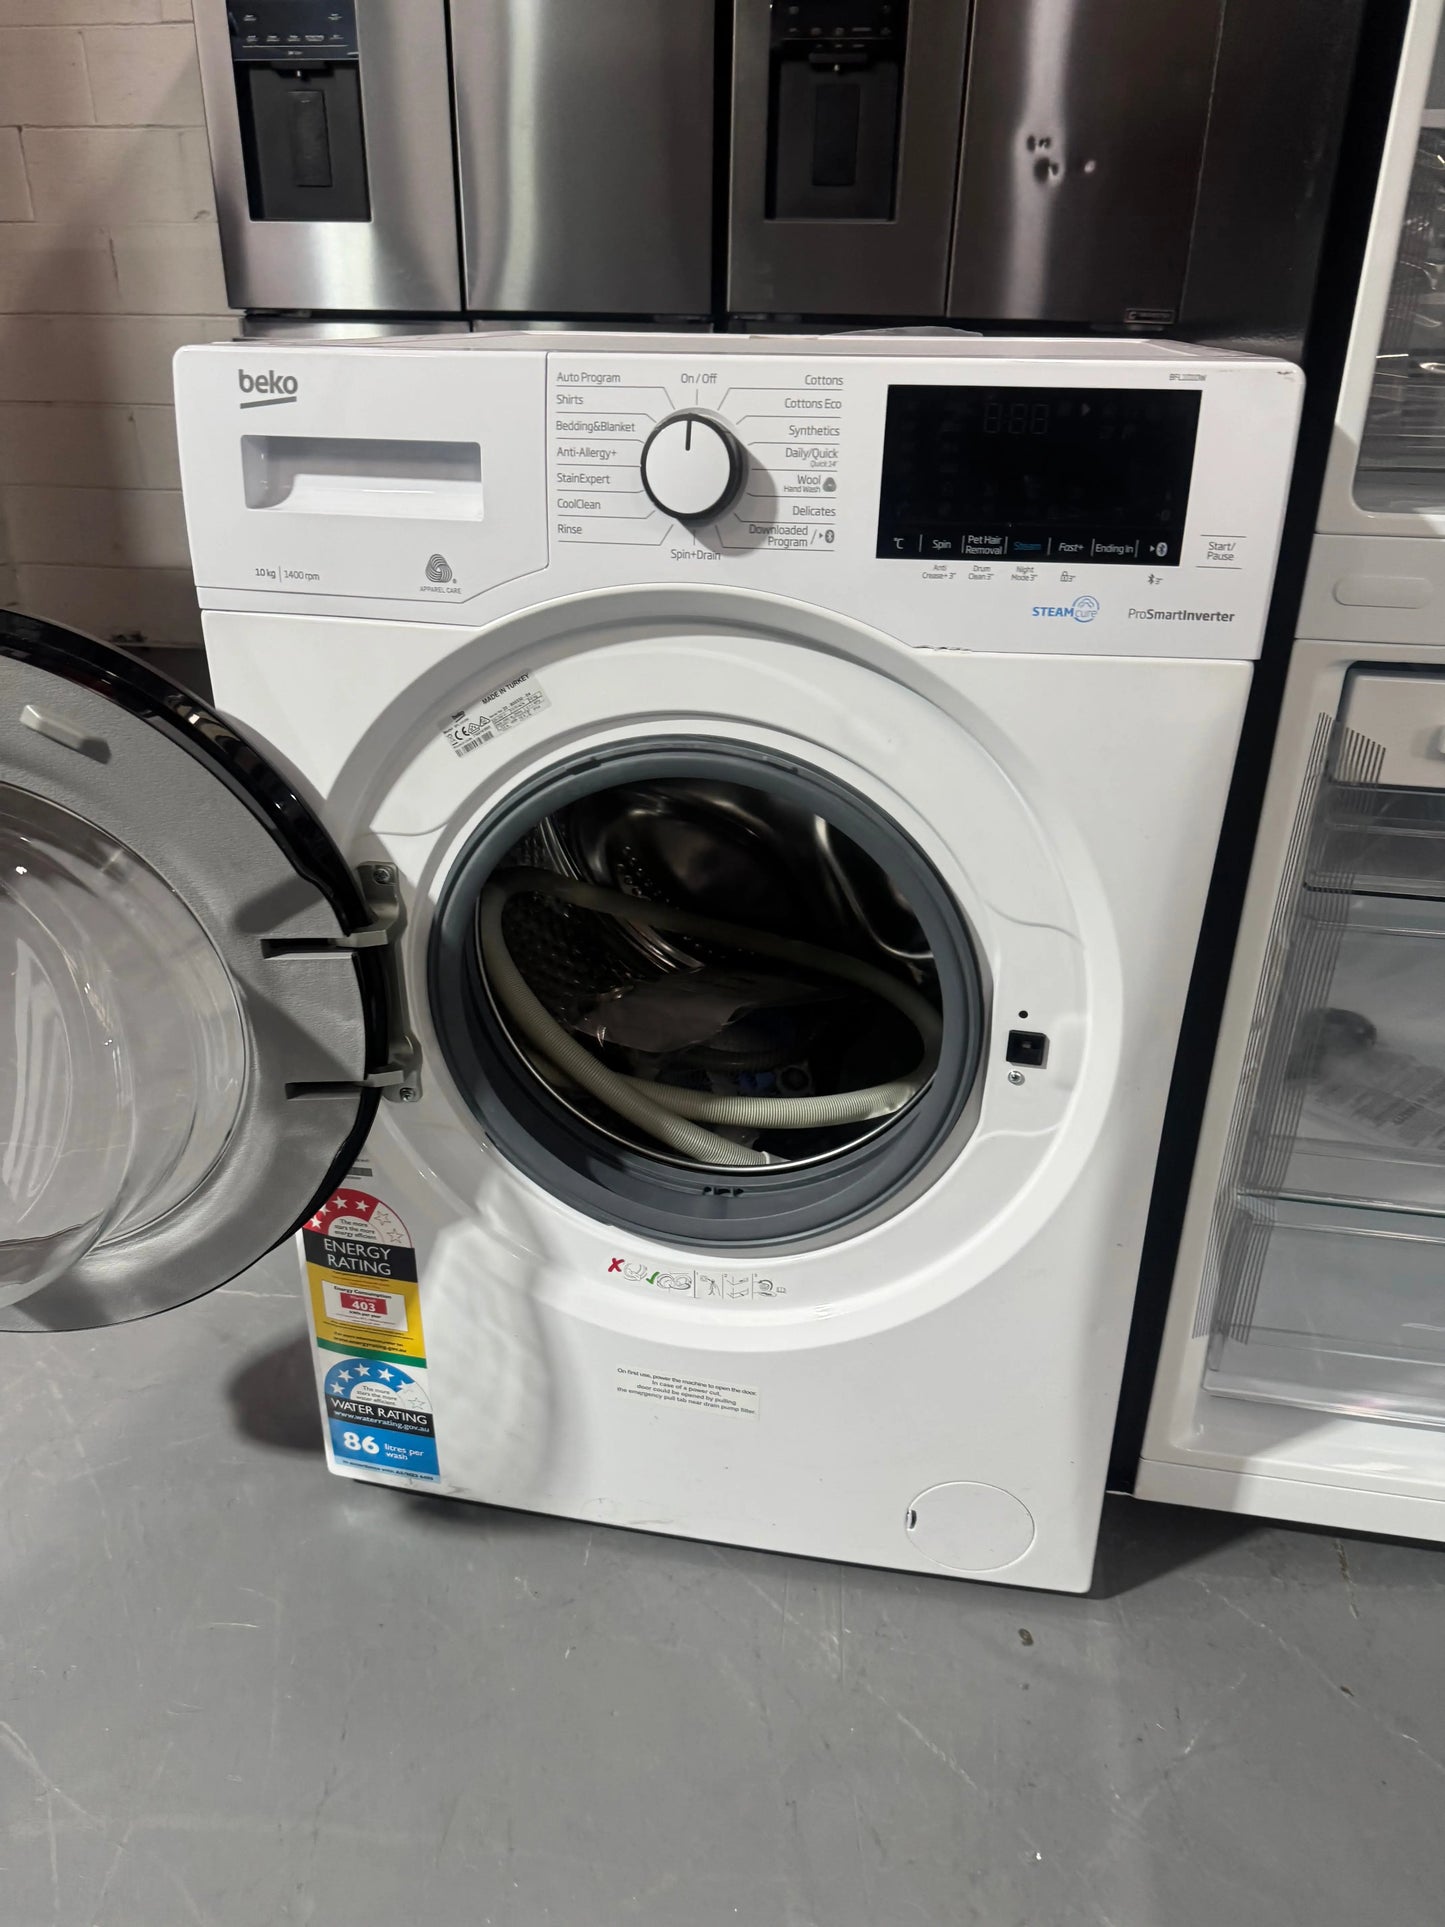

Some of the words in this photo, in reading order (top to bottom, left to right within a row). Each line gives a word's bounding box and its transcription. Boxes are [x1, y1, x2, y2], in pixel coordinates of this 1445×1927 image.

[238, 369, 298, 394] beko
[557, 372, 579, 382] Auto
[580, 372, 621, 385] Program
[680, 373, 694, 384] On
[702, 373, 717, 384] Off
[804, 374, 844, 386] Cottons
[556, 394, 584, 405] Shirts
[784, 398, 823, 410] Cottons
[824, 398, 842, 410] Eco
[556, 421, 636, 434] Bedding&Blanket
[789, 425, 840, 438] Synthetics
[556, 447, 617, 460] Anti-Allergy+
[785, 447, 839, 461] Daily/Quick
[556, 472, 611, 485] StainExpert
[797, 475, 821, 485] Wool
[557, 498, 601, 510] CoolClean
[792, 505, 836, 517] Delicates
[557, 524, 583, 535] Rinse
[749, 524, 808, 536] Downloaded
[767, 537, 808, 549] Program
[932, 539, 952, 551] Spin
[967, 535, 983, 545] Pet
[984, 536, 1001, 545] Hair
[965, 545, 1003, 555] Removal
[1058, 542, 1085, 552] Fast+
[1095, 543, 1124, 555] Ending
[1208, 541, 1236, 552] Start/
[670, 549, 721, 561] Spin+Drain
[1206, 551, 1235, 561] Pause
[255, 567, 265, 577] 10
[265, 568, 277, 580] kg
[283, 569, 304, 581] 1400
[305, 571, 321, 582] rpm
[1016, 565, 1035, 574] Night
[968, 572, 986, 581] Clean
[1011, 573, 1029, 582] Mode
[1127, 607, 1236, 622] ProSmartInverter
[482, 690, 500, 704] MADE
[499, 687, 507, 695] IN
[505, 673, 529, 690] TURKEY
[323, 1238, 391, 1260] ENERGY
[327, 1253, 391, 1276] RATING
[334, 1285, 353, 1294] Energy
[352, 1300, 376, 1312] 403
[682, 1379, 708, 1387] machine
[628, 1389, 662, 1399] emergency
[714, 1397, 737, 1406] pulling
[330, 1397, 374, 1416] WATER
[377, 1408, 428, 1425] RATING
[333, 1410, 430, 1433] www.waterrating.gov.au
[343, 1431, 380, 1455] 86
[384, 1442, 407, 1454] litres
[408, 1448, 425, 1457] per
[385, 1452, 408, 1461] wash
